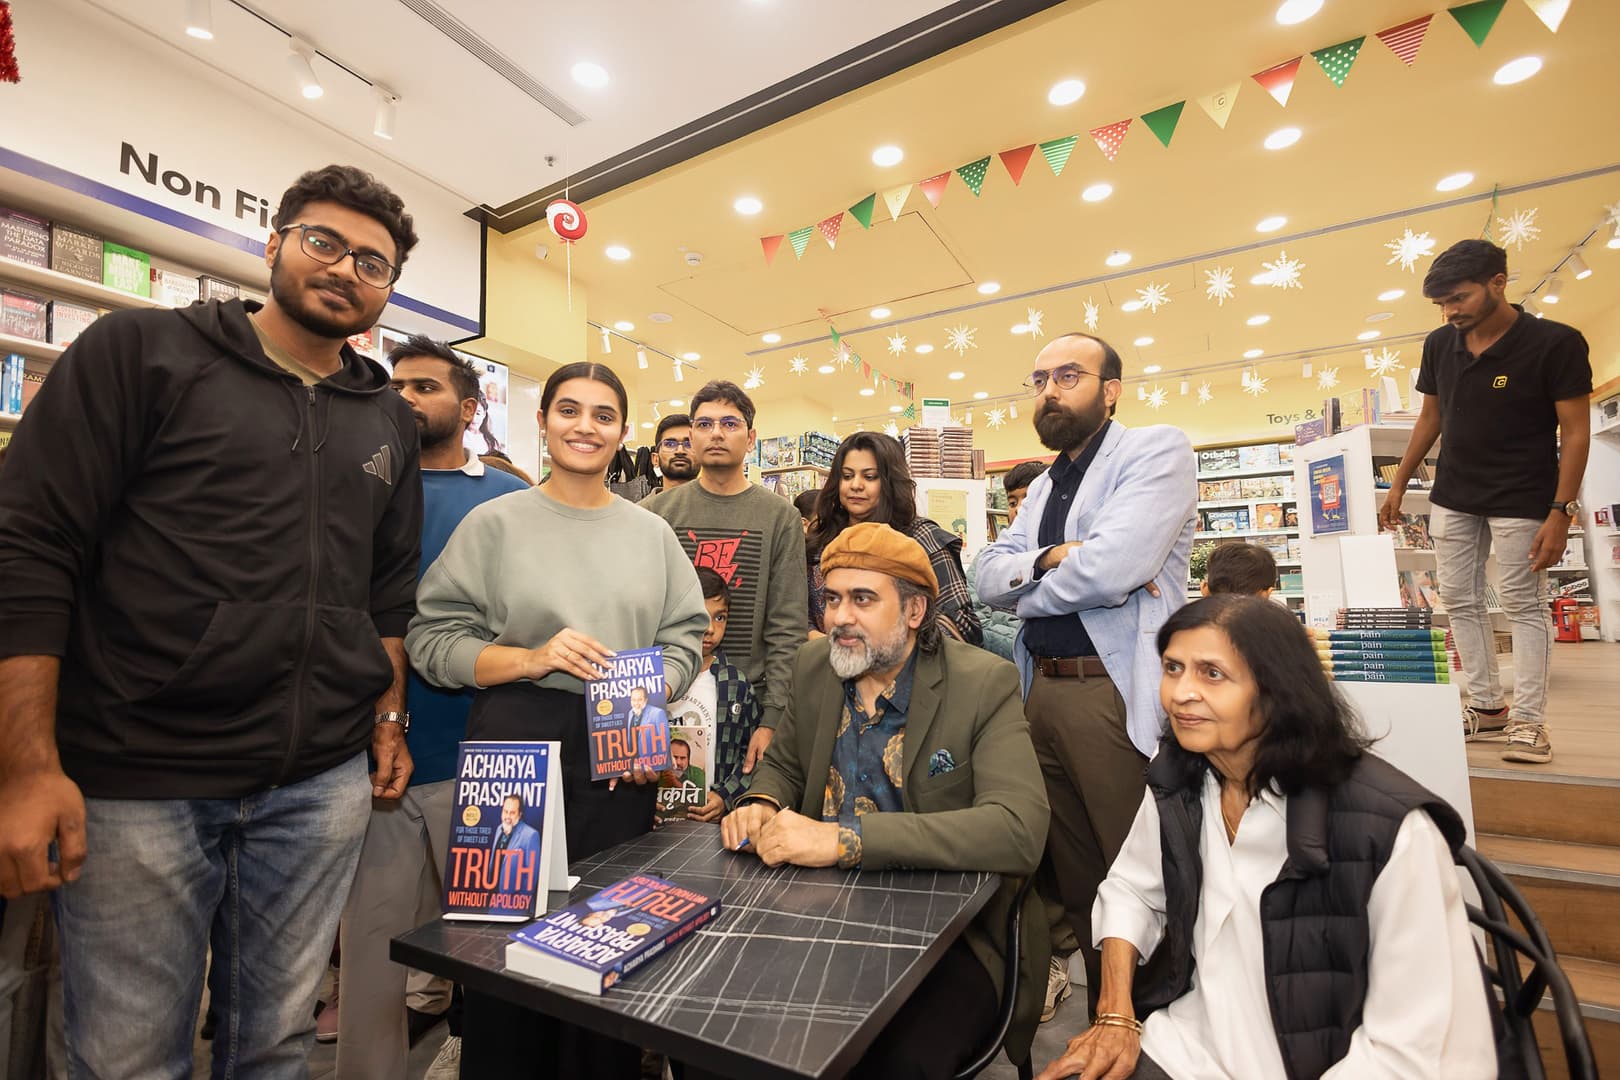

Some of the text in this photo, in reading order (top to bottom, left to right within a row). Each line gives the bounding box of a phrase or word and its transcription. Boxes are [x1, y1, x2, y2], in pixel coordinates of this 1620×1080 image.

[119, 140, 222, 211] Non
[1, 221, 49, 241] MASTERING
[4, 235, 46, 252] PARADOX
[1266, 412, 1300, 425] Toys
[1304, 409, 1316, 420] &
[1201, 449, 1237, 460] Othello
[1360, 631, 1381, 640] pain
[1361, 641, 1382, 650] pain
[1362, 651, 1384, 660] pain
[1363, 661, 1385, 670] pain
[1364, 671, 1386, 681] pain
[590, 675, 663, 701] PRASHANT
[680, 695, 712, 721] EPARTMENT
[591, 722, 667, 761] TRUTH
[461, 754, 536, 779] ACHARYA
[596, 758, 632, 774] WITHOUT
[458, 781, 545, 807] PRASHANT
[451, 847, 536, 891] TRUTH
[448, 890, 532, 910] WITHOUT APOLOGY
[601, 881, 697, 922] TRUTH
[545, 911, 645, 952] PRASHANT
[533, 925, 625, 965] ACHARYA
